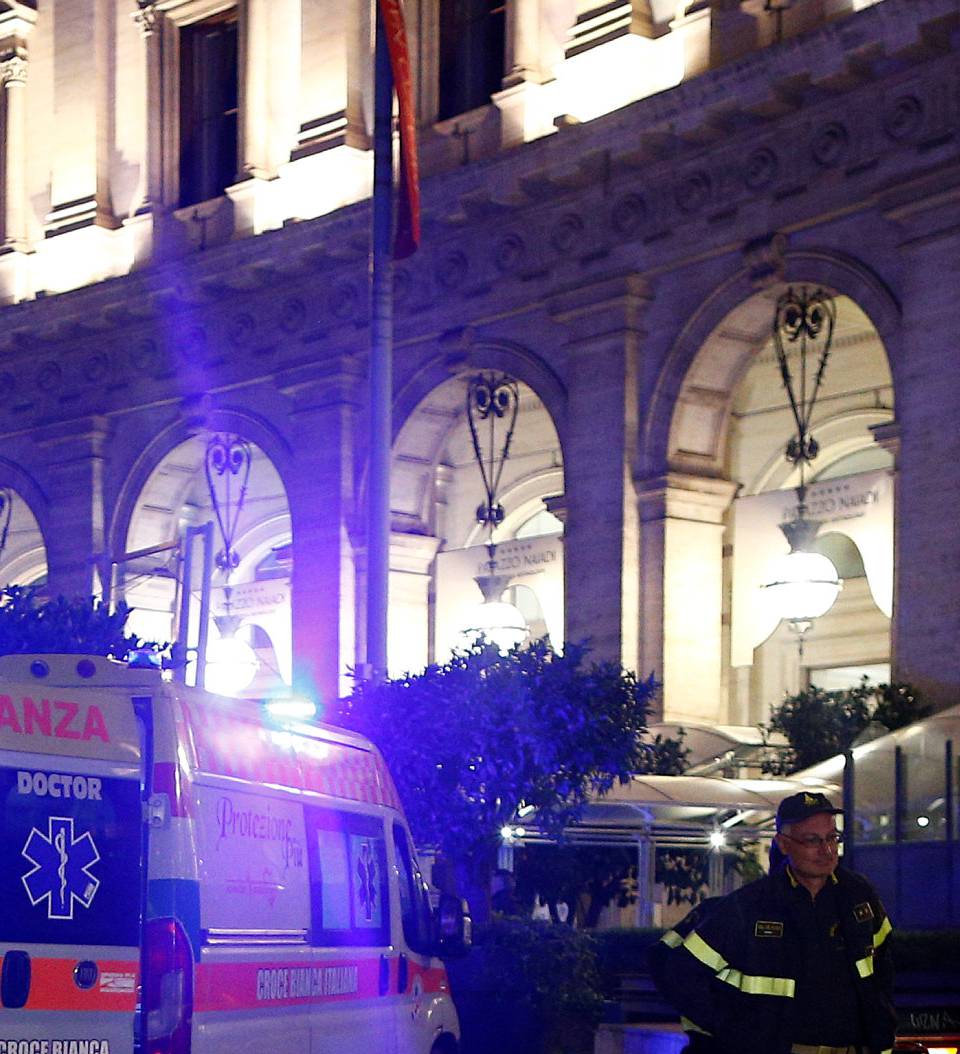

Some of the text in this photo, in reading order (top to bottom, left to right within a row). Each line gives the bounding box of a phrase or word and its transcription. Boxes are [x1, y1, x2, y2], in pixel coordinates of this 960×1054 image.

[0, 694, 110, 743] ANZA
[17, 771, 102, 801] DOCTOR
[257, 969, 289, 1000] CROCE
